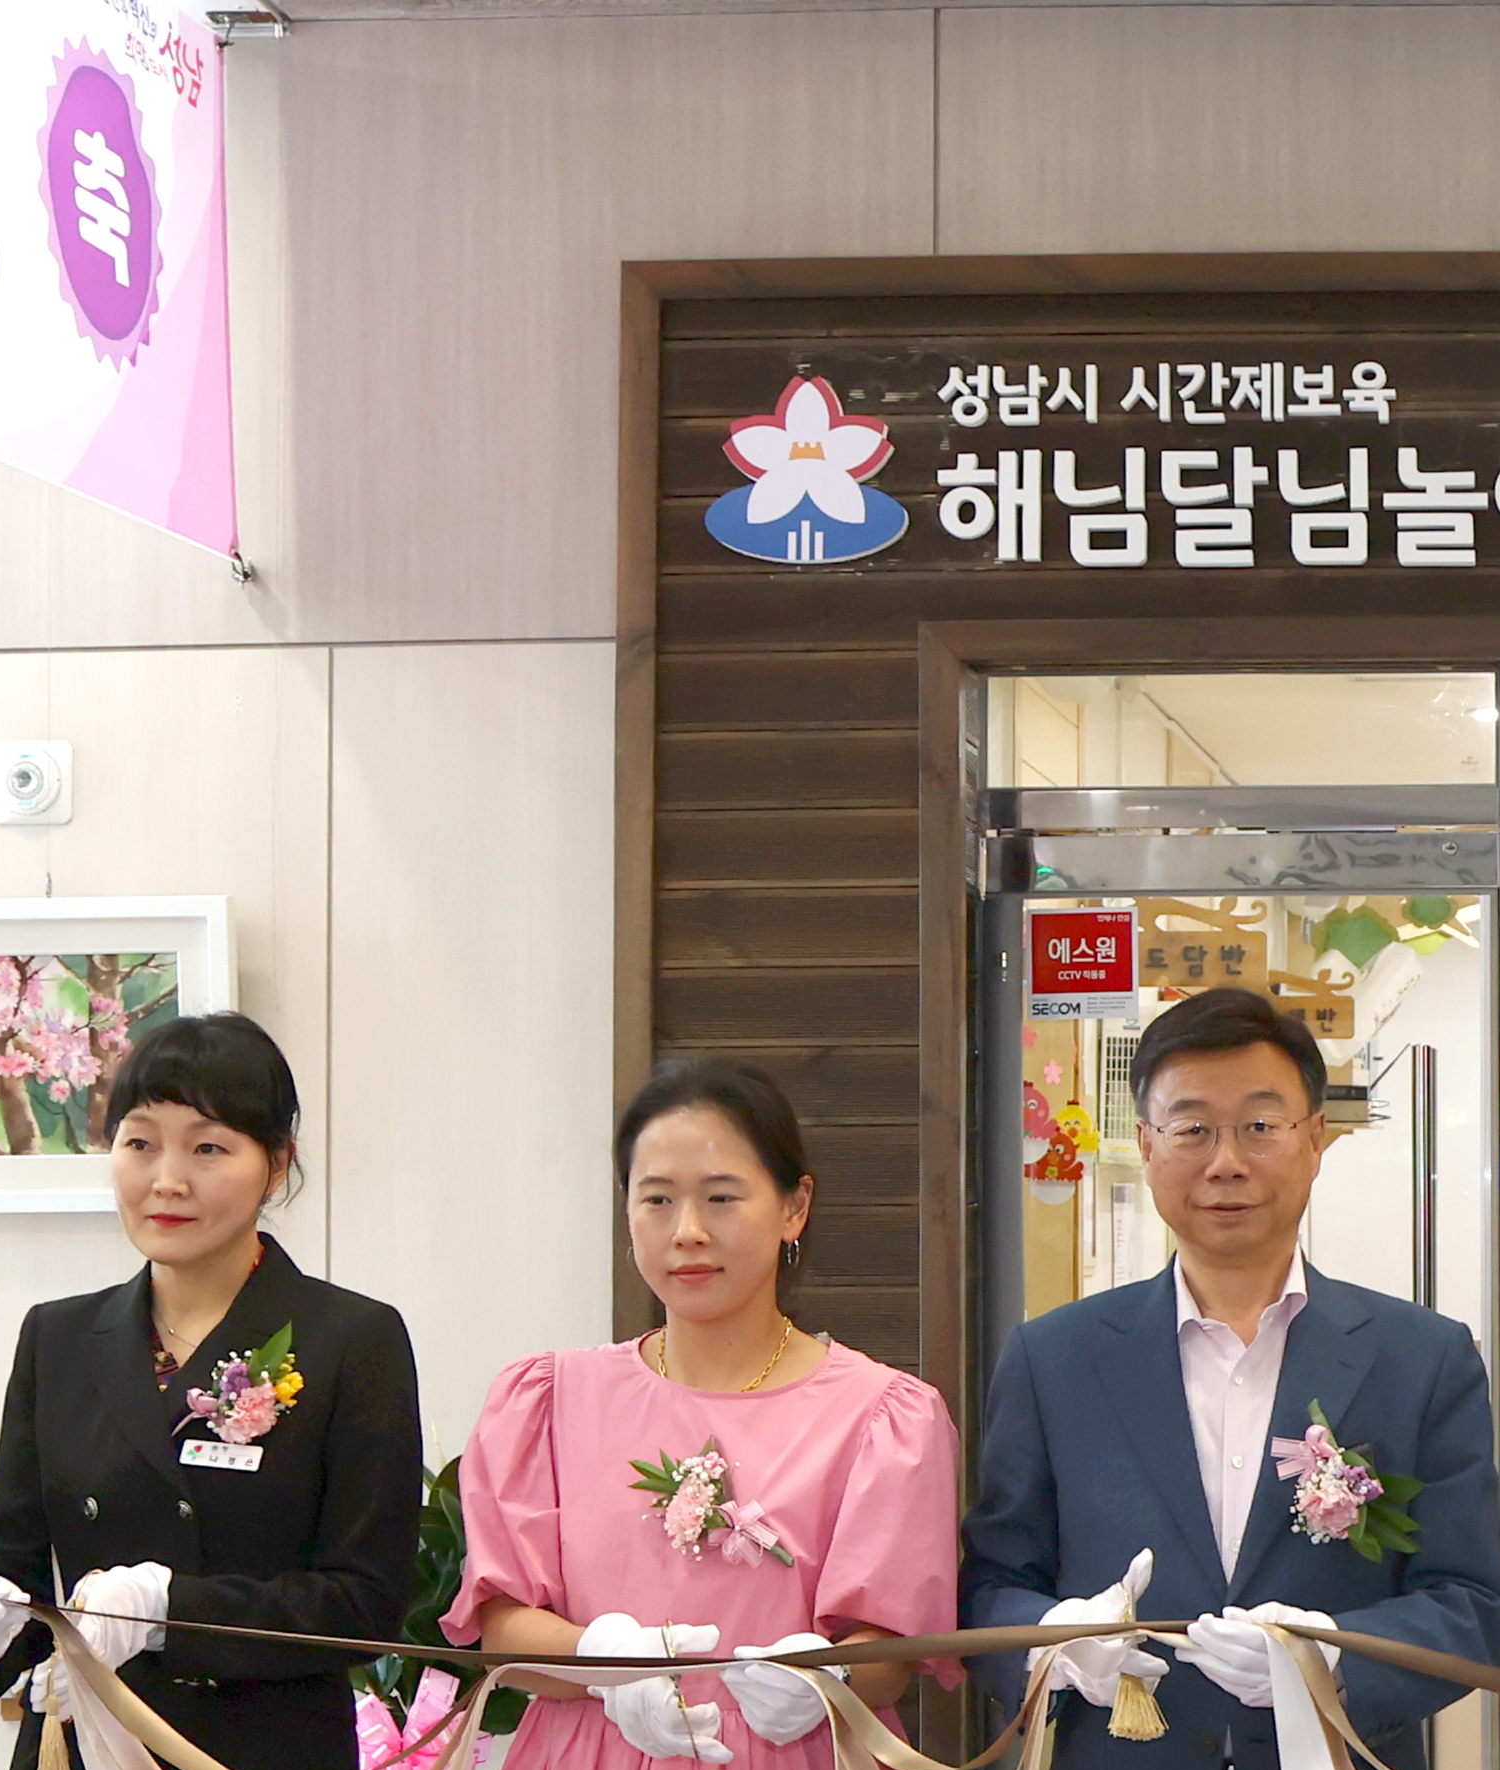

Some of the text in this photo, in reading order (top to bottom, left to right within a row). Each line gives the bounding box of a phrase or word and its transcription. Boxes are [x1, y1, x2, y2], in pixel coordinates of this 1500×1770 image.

[124, 32, 169, 84] 희망도시
[159, 21, 204, 108] 성남
[73, 128, 131, 287] 축
[937, 360, 1397, 428] 성남시 시간제보육
[1048, 936, 1117, 964] 에스원
[1057, 970, 1081, 980] CCTV
[1032, 1002, 1081, 1015] SECOM
